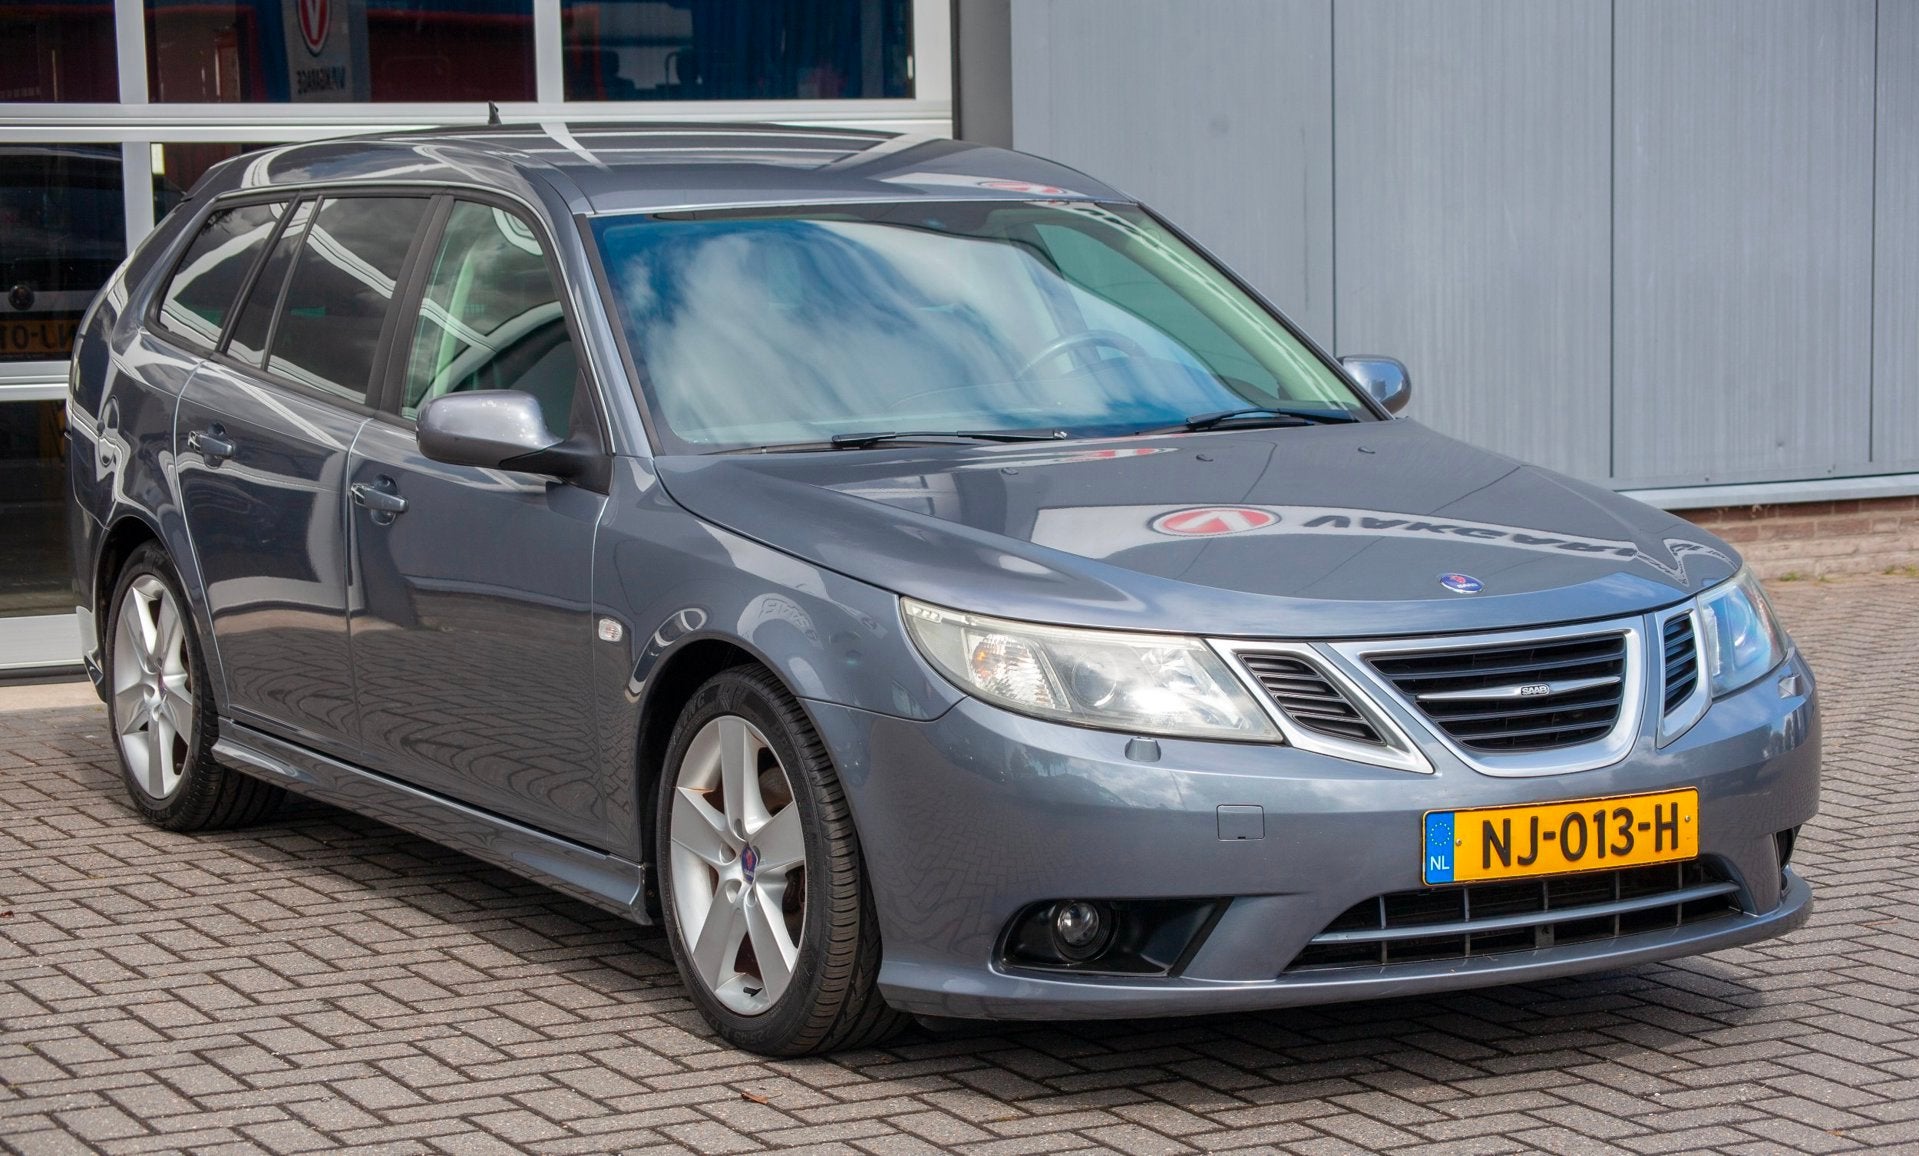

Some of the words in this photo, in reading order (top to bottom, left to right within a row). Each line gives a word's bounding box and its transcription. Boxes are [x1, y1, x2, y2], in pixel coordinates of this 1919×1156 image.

[1521, 685, 1549, 696] SAAB
[1482, 802, 1679, 869] NJ-013-H
[1430, 855, 1450, 871] NL
